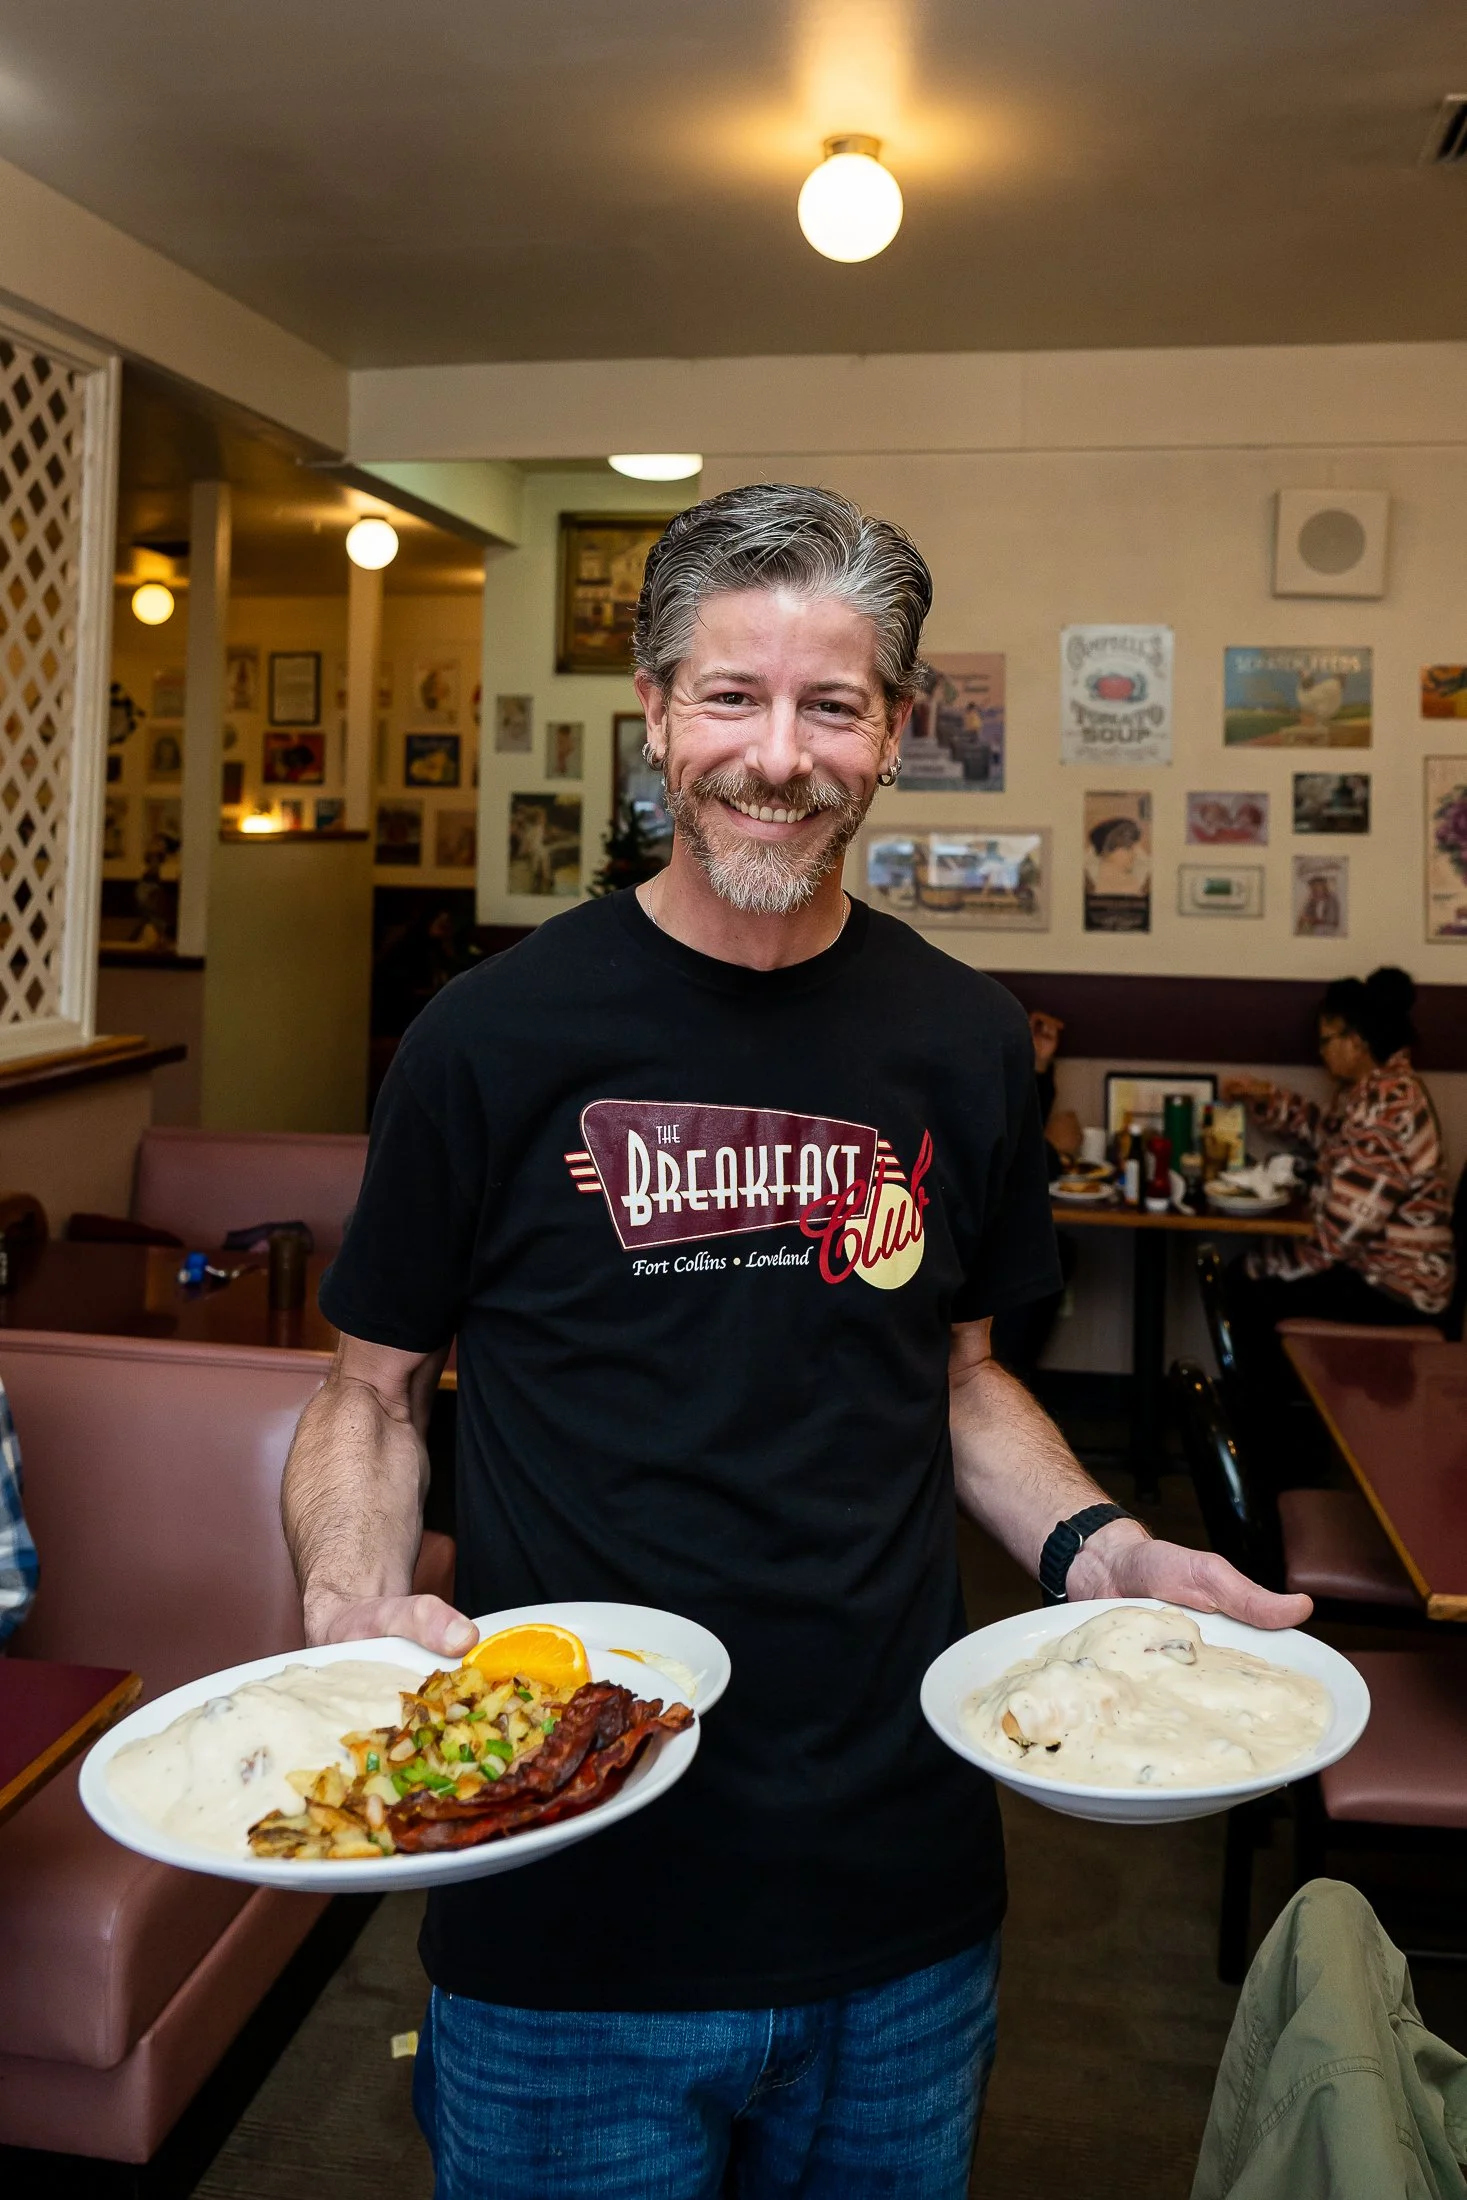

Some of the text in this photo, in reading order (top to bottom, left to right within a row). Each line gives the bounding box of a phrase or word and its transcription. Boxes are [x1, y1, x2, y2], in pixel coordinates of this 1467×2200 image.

[655, 1123, 680, 1145] THE
[621, 1129, 861, 1227] BREAKFAST
[800, 1128, 933, 1284] Club
[632, 1245, 814, 1276] Fort Collins Loveland
